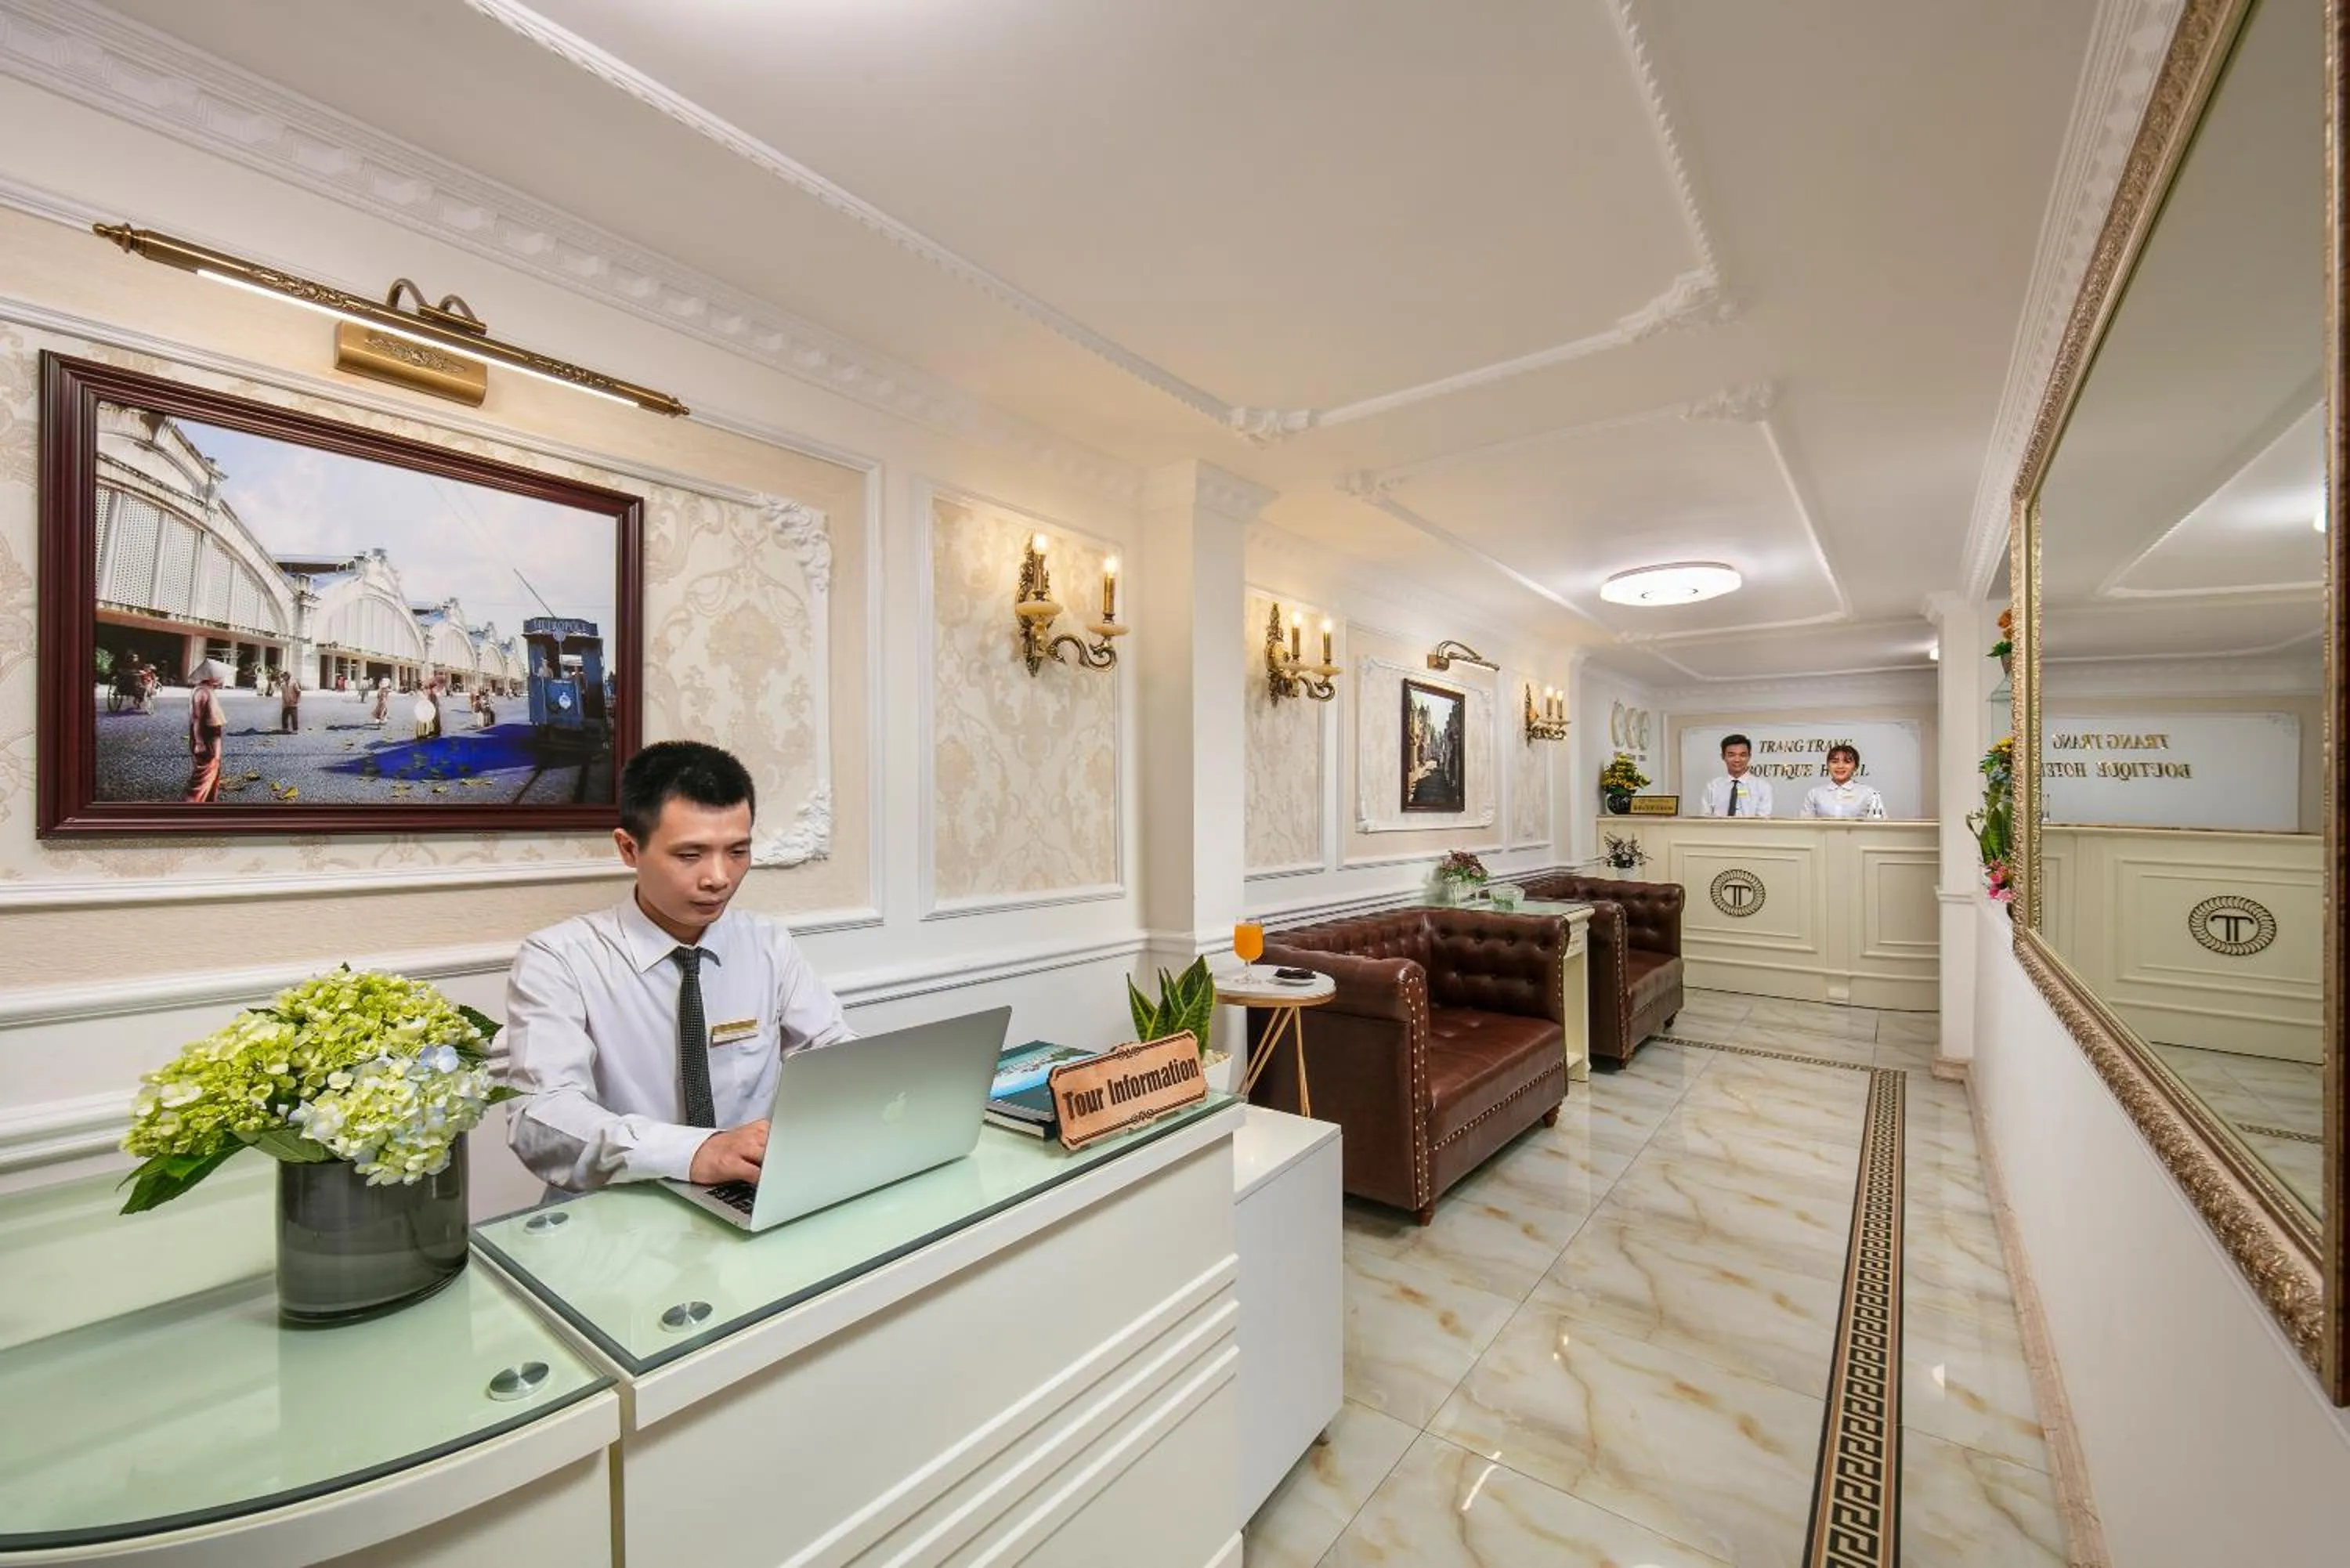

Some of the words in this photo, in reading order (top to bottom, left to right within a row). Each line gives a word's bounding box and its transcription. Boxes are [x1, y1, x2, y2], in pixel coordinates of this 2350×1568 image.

[1759, 739, 1803, 753] TRANG
[1062, 1088, 1104, 1120] Tour
[1107, 1057, 1199, 1105] Information
